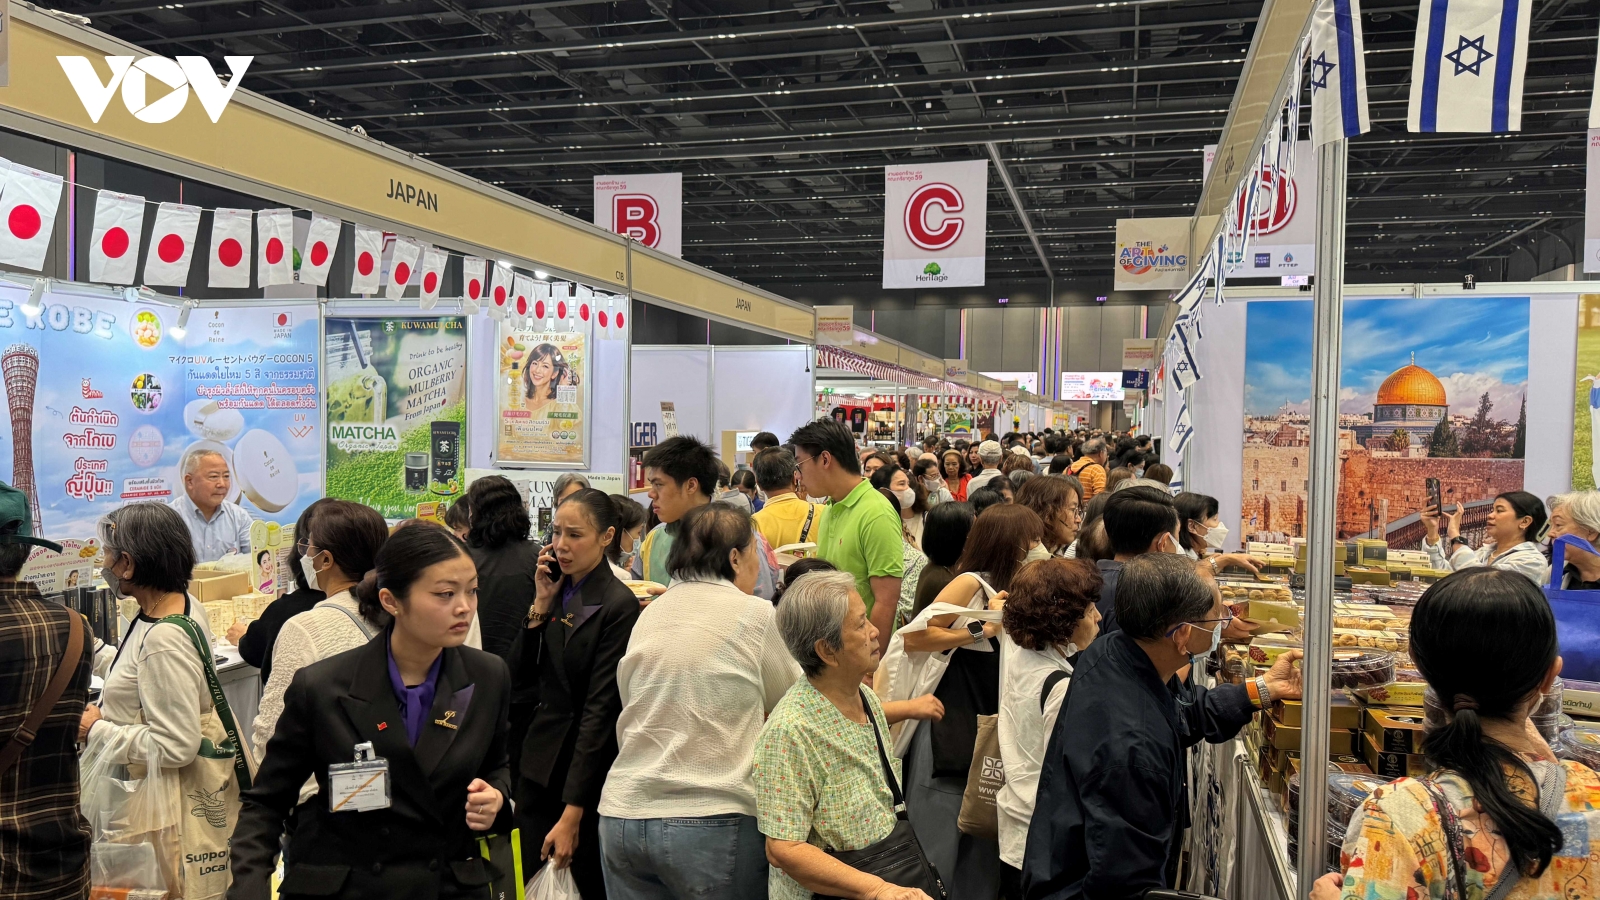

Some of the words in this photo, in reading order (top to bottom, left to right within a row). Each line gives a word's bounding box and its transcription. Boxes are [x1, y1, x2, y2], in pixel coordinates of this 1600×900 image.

[386, 179, 438, 213] JAPAN
[612, 193, 661, 249] B
[904, 182, 964, 251] C
[1120, 247, 1151, 258] ART
[1132, 255, 1187, 267] GIVING
[615, 270, 624, 281] C1B
[915, 272, 948, 282] Heritage
[735, 297, 751, 312] JAPAN
[385, 321, 394, 332] 茶
[307, 354, 313, 363] 5
[409, 351, 427, 360] Drink
[427, 348, 435, 356] to
[245, 370, 251, 379] 5
[408, 358, 454, 380] ORGANIC
[407, 370, 456, 396] MULBERRY
[406, 387, 446, 410] MATCHA
[71, 408, 117, 425] ต้นกำเนิด
[294, 413, 306, 421] UV
[405, 409, 422, 421] From
[423, 403, 440, 415] Japan
[65, 431, 115, 448] จากโกเบ
[332, 426, 396, 440] MATCHA
[630, 422, 657, 446] IGER
[338, 441, 369, 451] Organic
[375, 442, 397, 450] Japan
[76, 459, 106, 470] ประเทศ
[384, 503, 400, 517] you
[404, 503, 418, 513] ver
[186, 850, 229, 864] Suppo
[200, 861, 228, 876] Local
